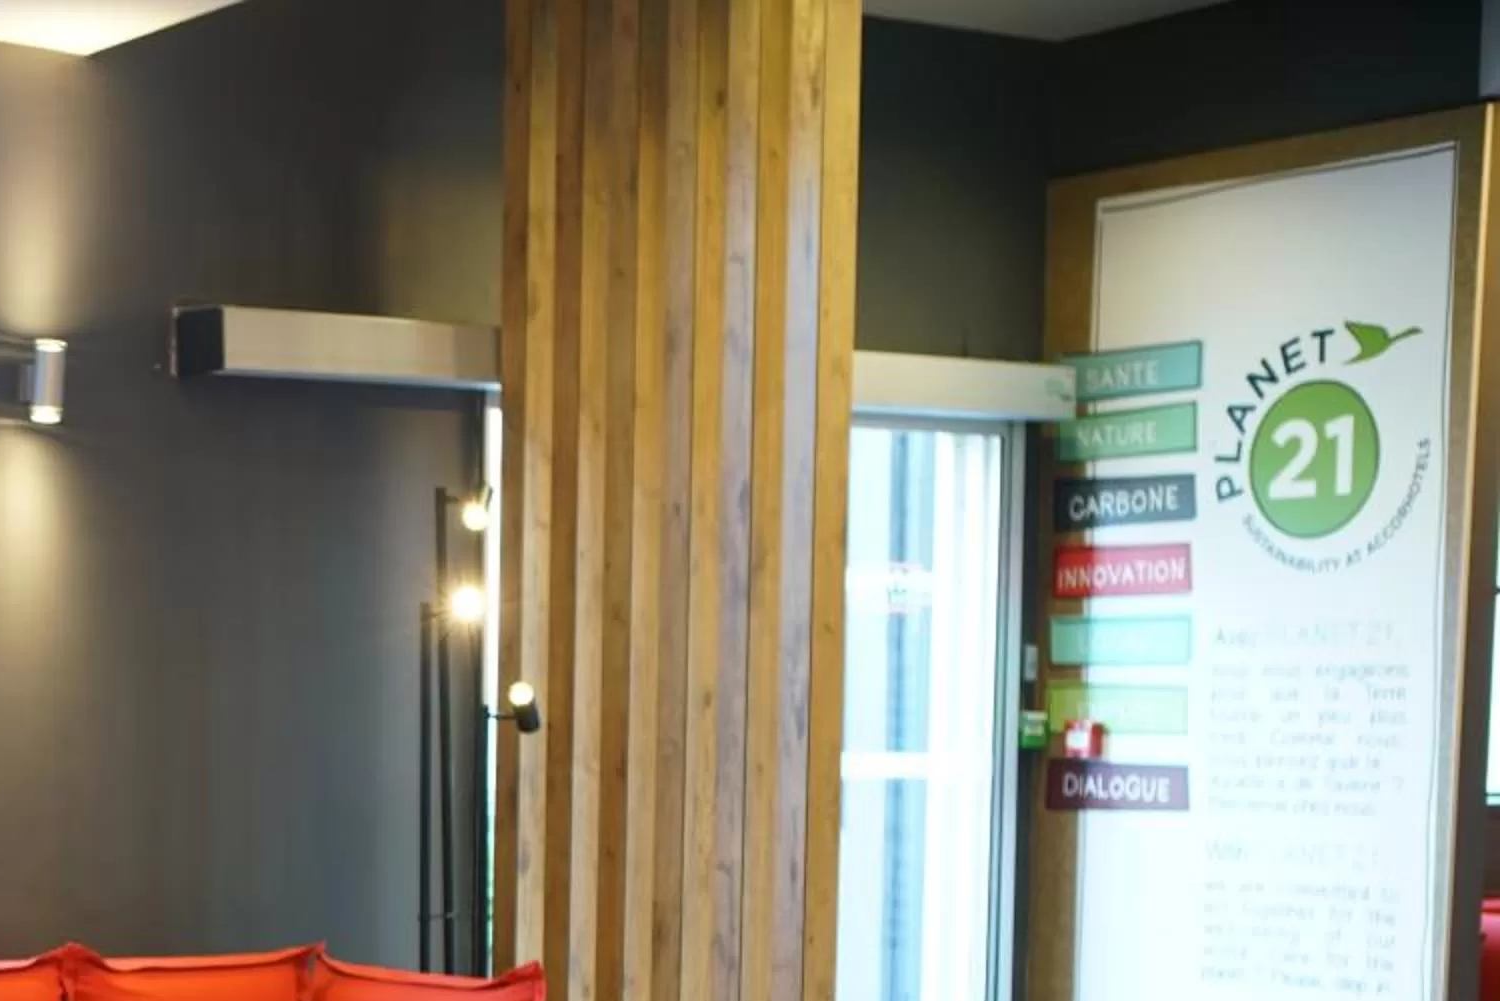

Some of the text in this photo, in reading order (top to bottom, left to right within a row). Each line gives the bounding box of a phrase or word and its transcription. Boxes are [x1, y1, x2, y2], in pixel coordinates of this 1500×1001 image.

[1213, 327, 1336, 504] PLANET
[1076, 421, 1157, 448] NATURE
[1267, 413, 1355, 501] 21
[1068, 484, 1180, 522] CARBONE
[1056, 555, 1187, 590] INNOVATION
[1062, 772, 1172, 804] DIALOGUE
